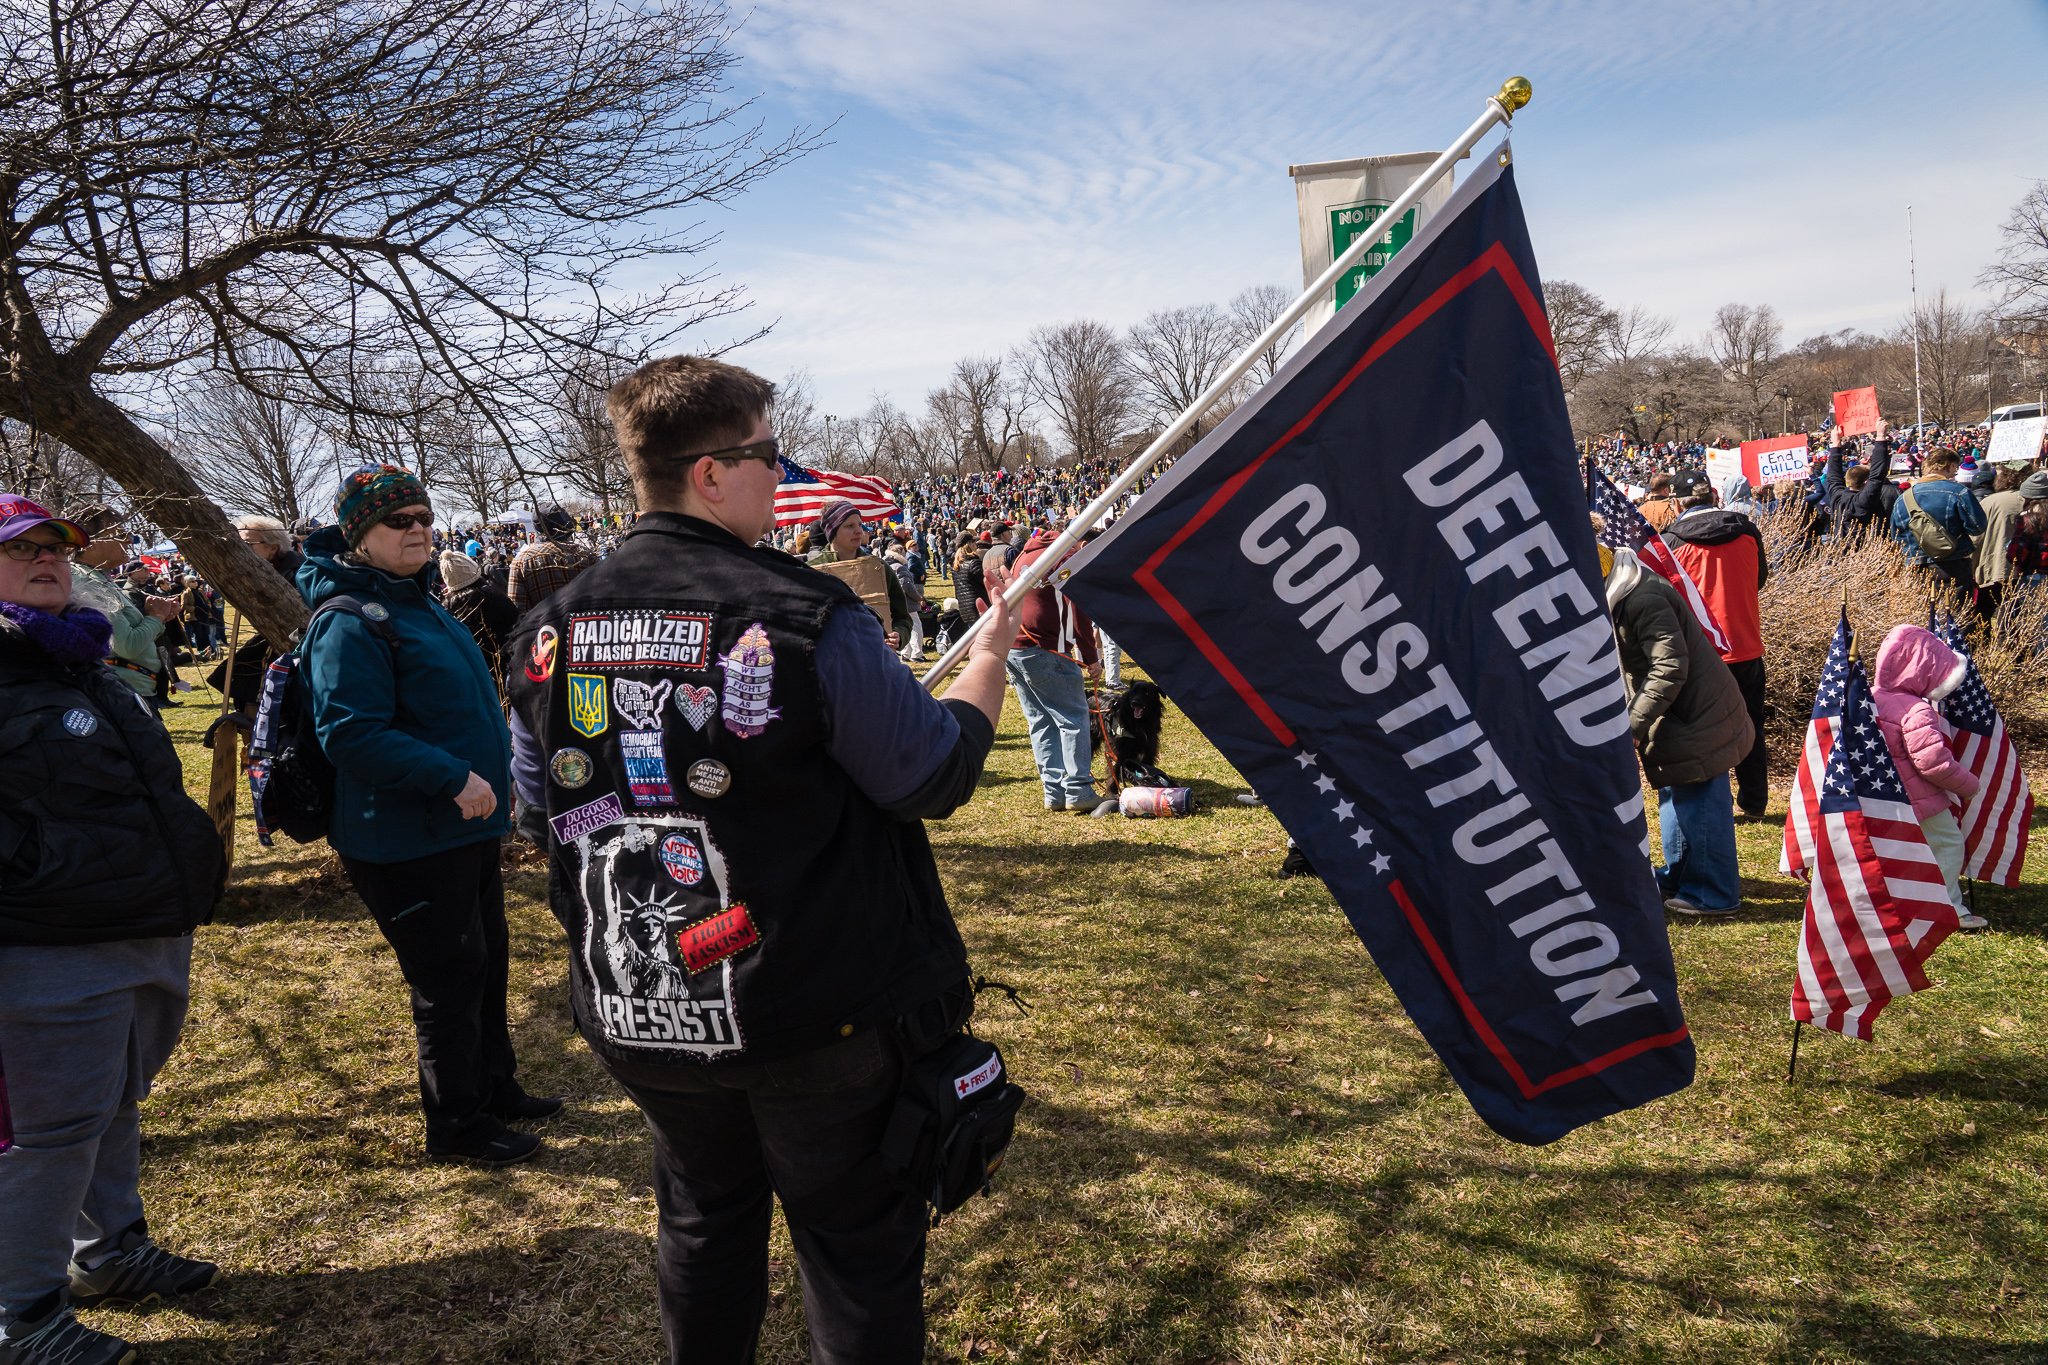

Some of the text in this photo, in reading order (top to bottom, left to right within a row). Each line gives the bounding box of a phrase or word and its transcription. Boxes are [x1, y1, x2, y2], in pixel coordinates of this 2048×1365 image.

[1768, 450, 1794, 464] End
[1762, 460, 1804, 476] CHILD
[1402, 419, 1630, 747] DEFEND
[573, 619, 703, 645] RADICALIZED
[573, 643, 701, 663] BY BASIC DECENCY
[742, 667, 756, 675] WE
[733, 681, 762, 693] FIGHT
[66, 710, 79, 727] ANTIFA
[72, 712, 84, 729] MEANS
[79, 717, 88, 729] ANTI
[733, 714, 754, 724] ONE
[621, 732, 662, 746] DEMOCRACY
[1240, 483, 1659, 1027] CONSTITUTION
[695, 770, 724, 783] MEANS
[697, 763, 725, 776] ANTIFA
[689, 781, 721, 795] FASCIST
[698, 778, 717, 788] ANTI
[566, 800, 611, 826] DO GOOD
[665, 841, 698, 860] VOTE
[667, 852, 677, 862] IS
[692, 914, 735, 945] FIGHT
[689, 927, 752, 965] FASCISM
[602, 994, 725, 1041] RESIST
[970, 1069, 989, 1088] FIRST
